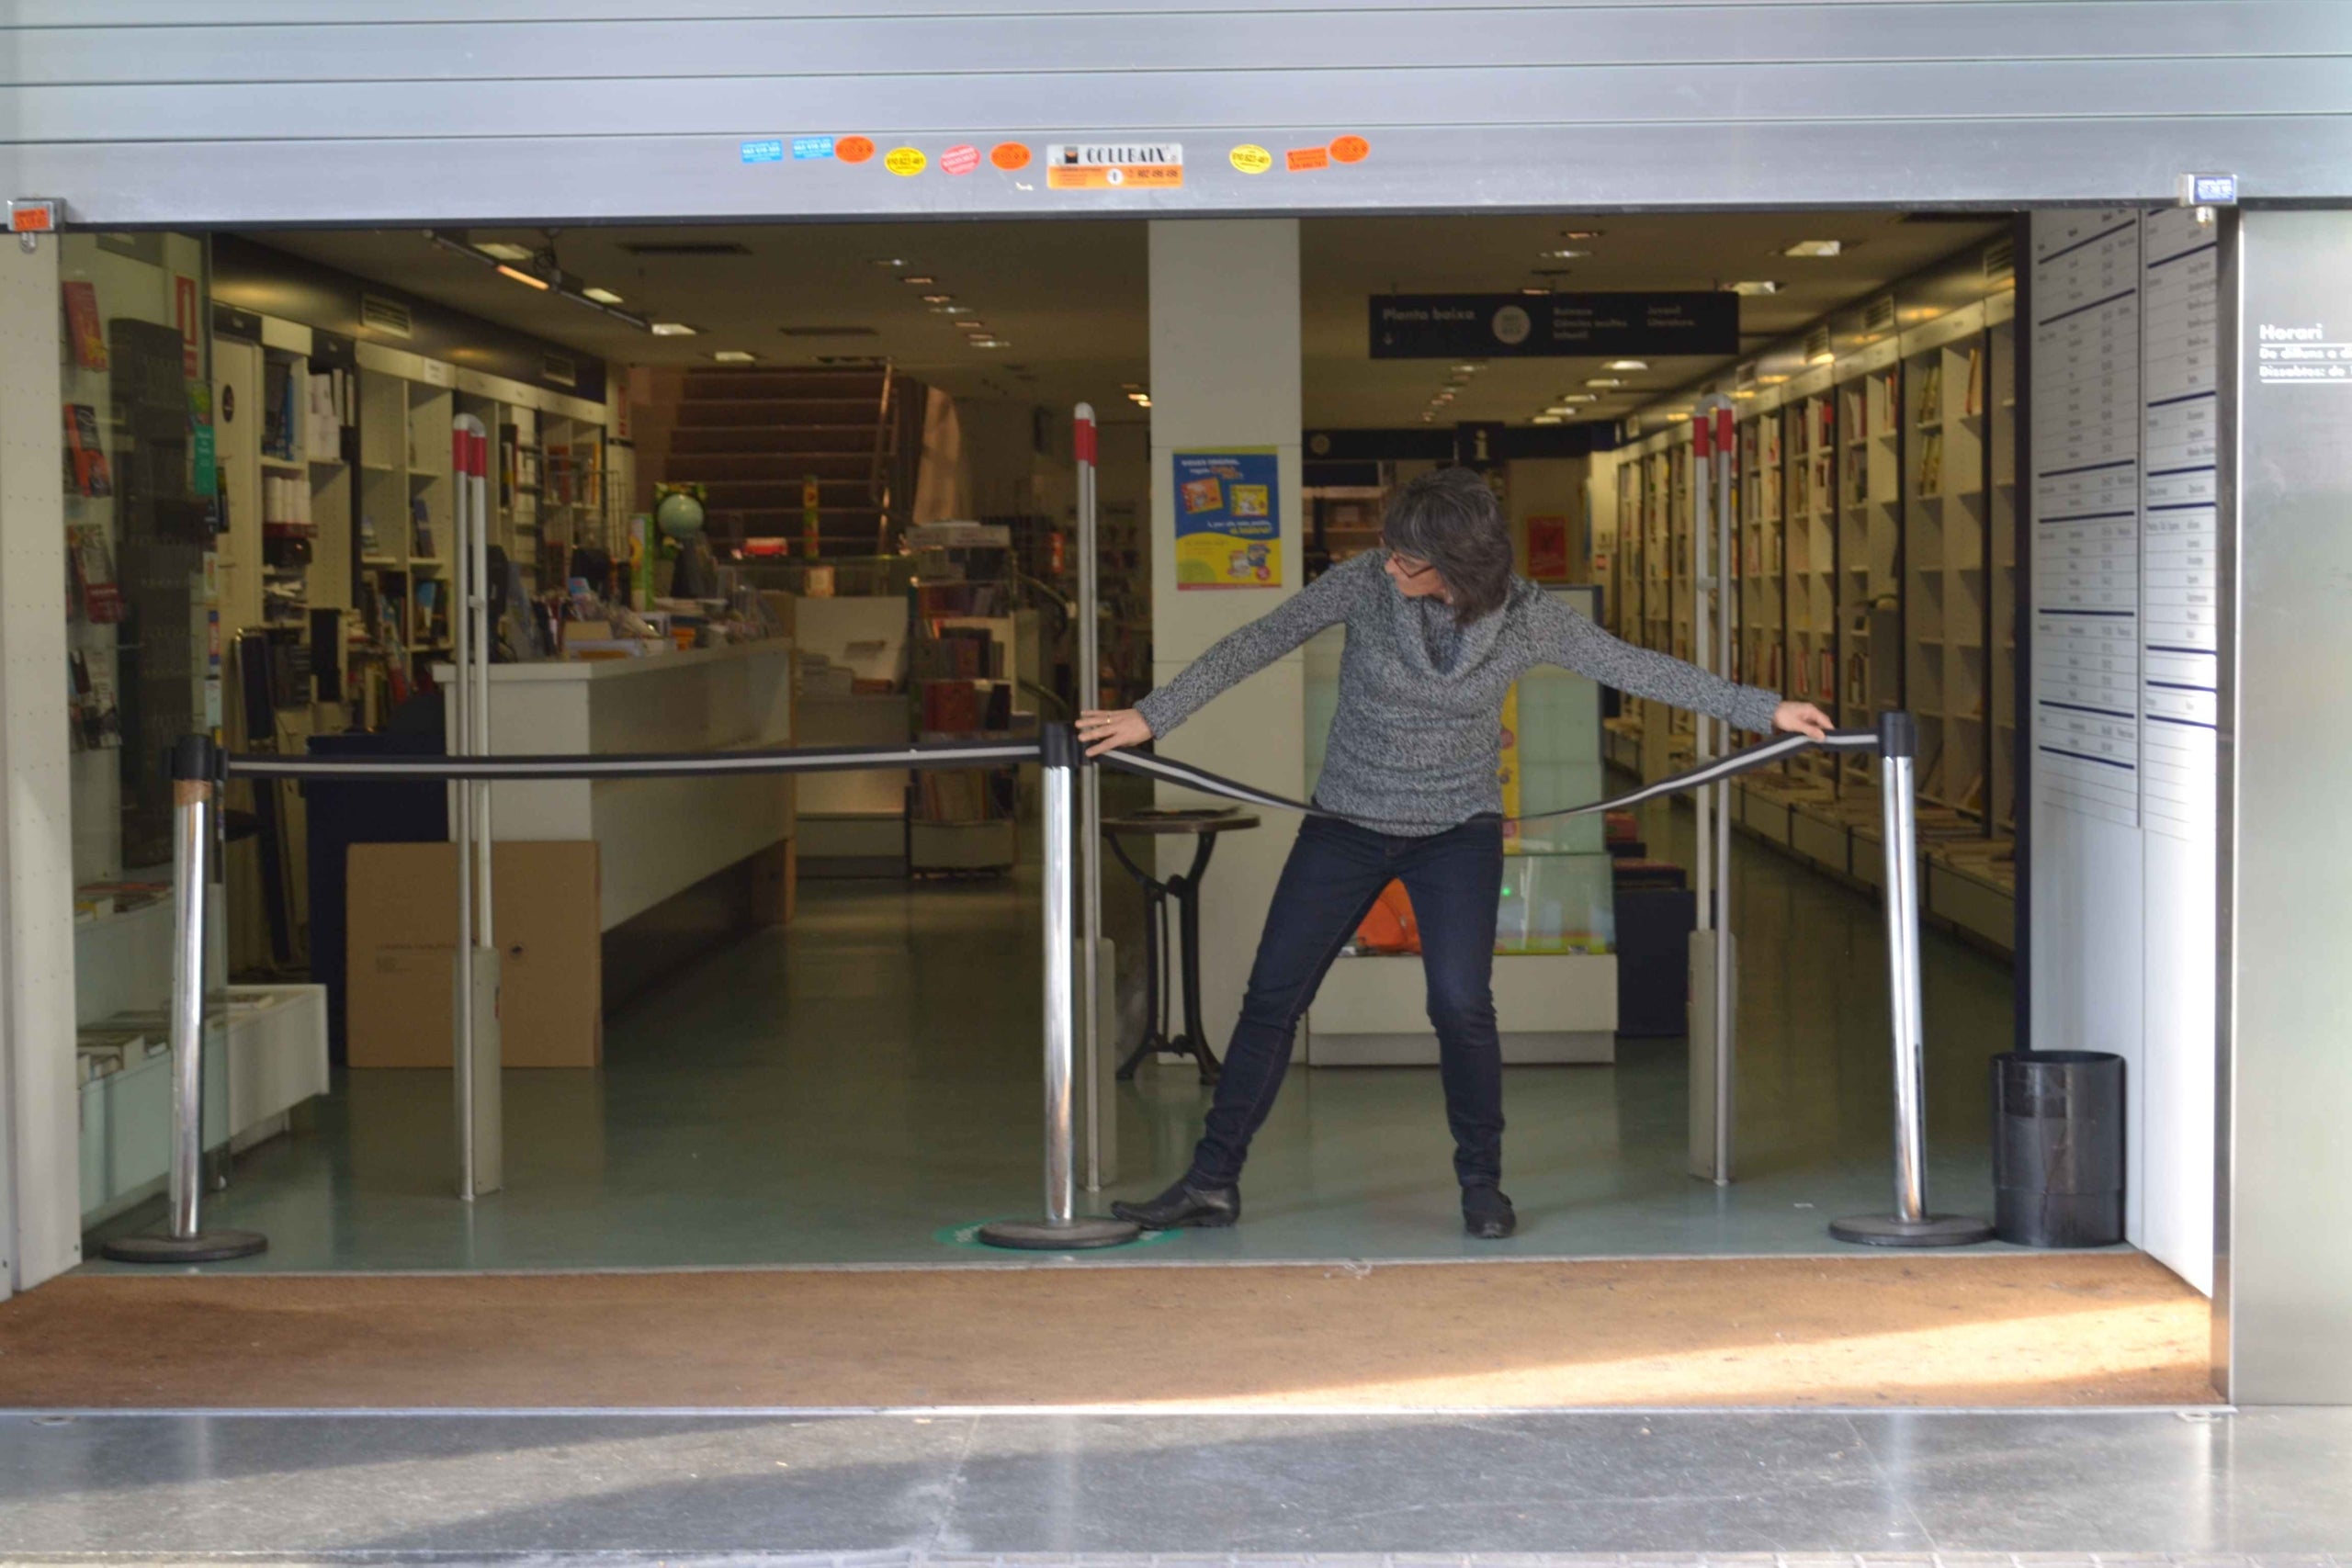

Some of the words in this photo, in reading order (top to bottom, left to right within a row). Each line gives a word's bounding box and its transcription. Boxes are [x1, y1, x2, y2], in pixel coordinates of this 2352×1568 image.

[1382, 307, 1429, 321] Planta
[1432, 306, 1475, 321] baixa
[2259, 322, 2323, 341] Horari
[2259, 347, 2277, 359] De
